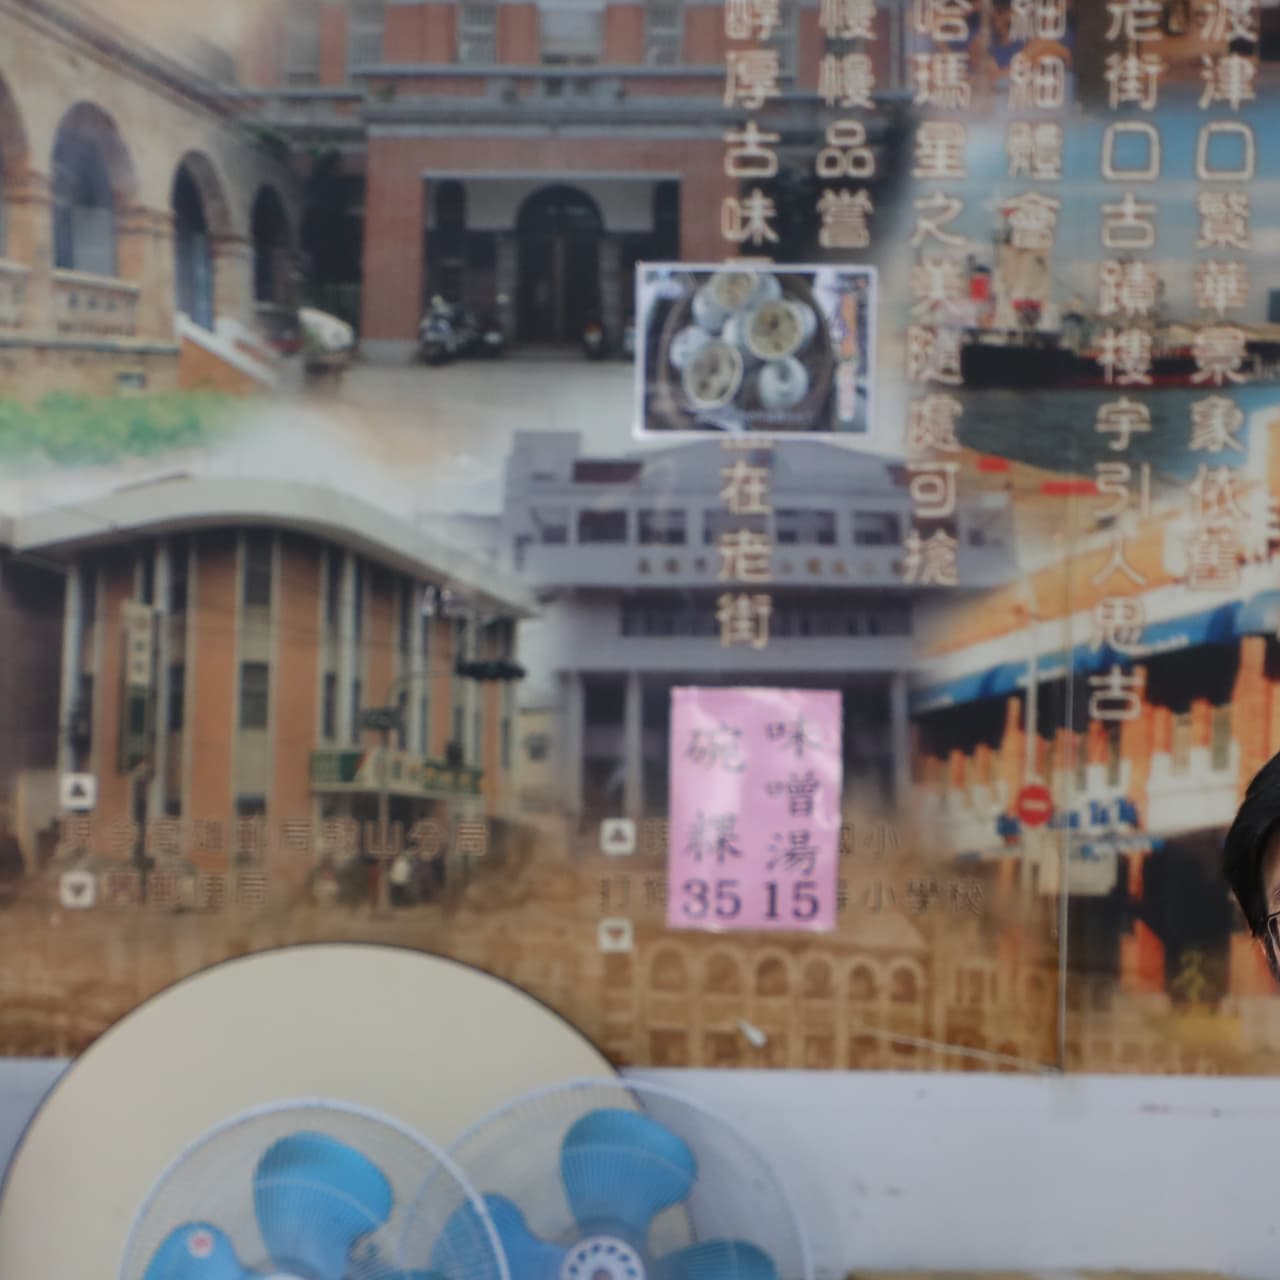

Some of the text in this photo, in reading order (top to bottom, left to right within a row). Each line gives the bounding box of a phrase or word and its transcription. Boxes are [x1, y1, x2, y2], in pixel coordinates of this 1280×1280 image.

[763, 714, 824, 921] 味噌湯 15
[682, 878, 742, 920] 35
